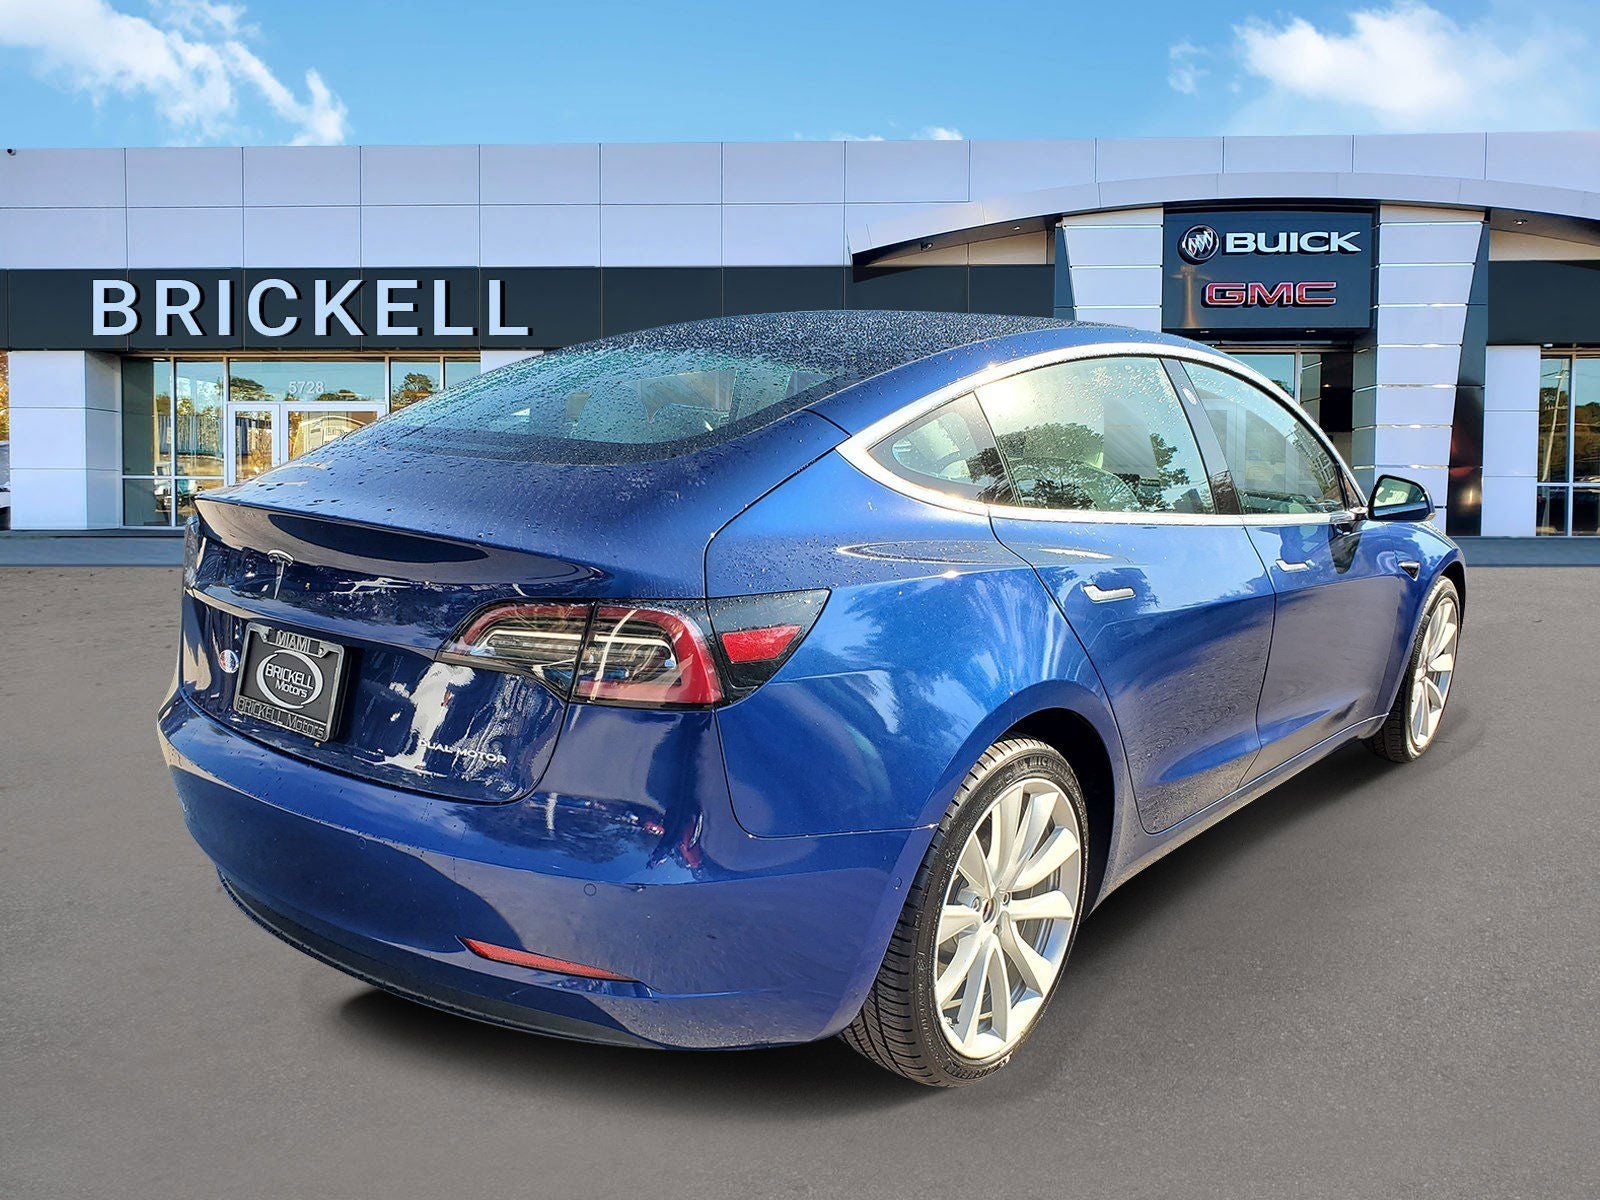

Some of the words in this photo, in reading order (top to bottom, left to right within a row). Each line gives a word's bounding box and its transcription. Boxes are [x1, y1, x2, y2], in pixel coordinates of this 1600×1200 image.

[1225, 231, 1362, 254] BUICK
[1205, 281, 1337, 306] GMC
[91, 278, 531, 338] BRICKELL
[288, 381, 325, 395] 5728
[275, 629, 311, 653] MIAMI
[265, 663, 314, 690] BRICKELL
[275, 680, 308, 699] Motors
[237, 697, 283, 725] BRICKELL
[419, 739, 453, 754] DUAL
[459, 747, 507, 764] MOTOR
